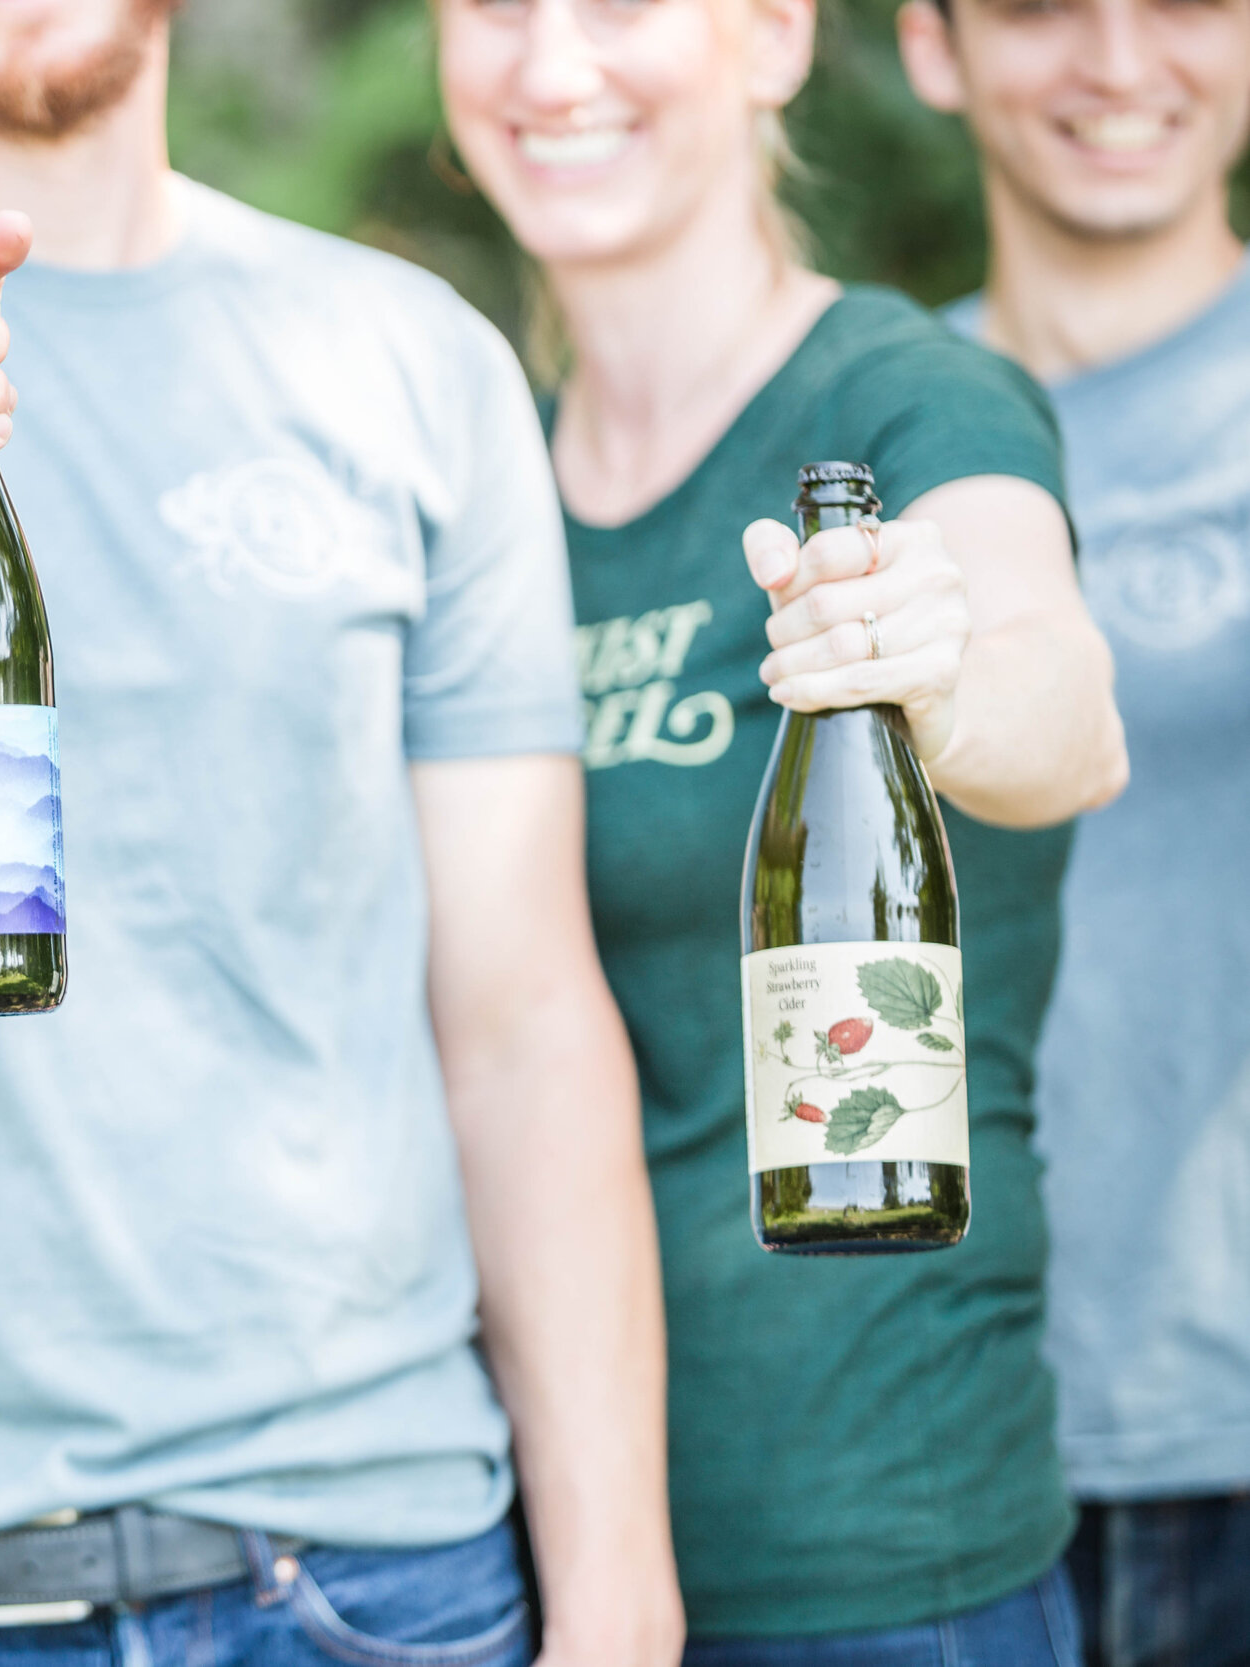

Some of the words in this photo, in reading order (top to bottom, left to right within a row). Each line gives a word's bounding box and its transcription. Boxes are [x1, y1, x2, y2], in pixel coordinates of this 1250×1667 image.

[768, 957, 817, 977] Sparkling
[766, 976, 821, 995] Strawberry
[779, 996, 806, 1011] Cider
